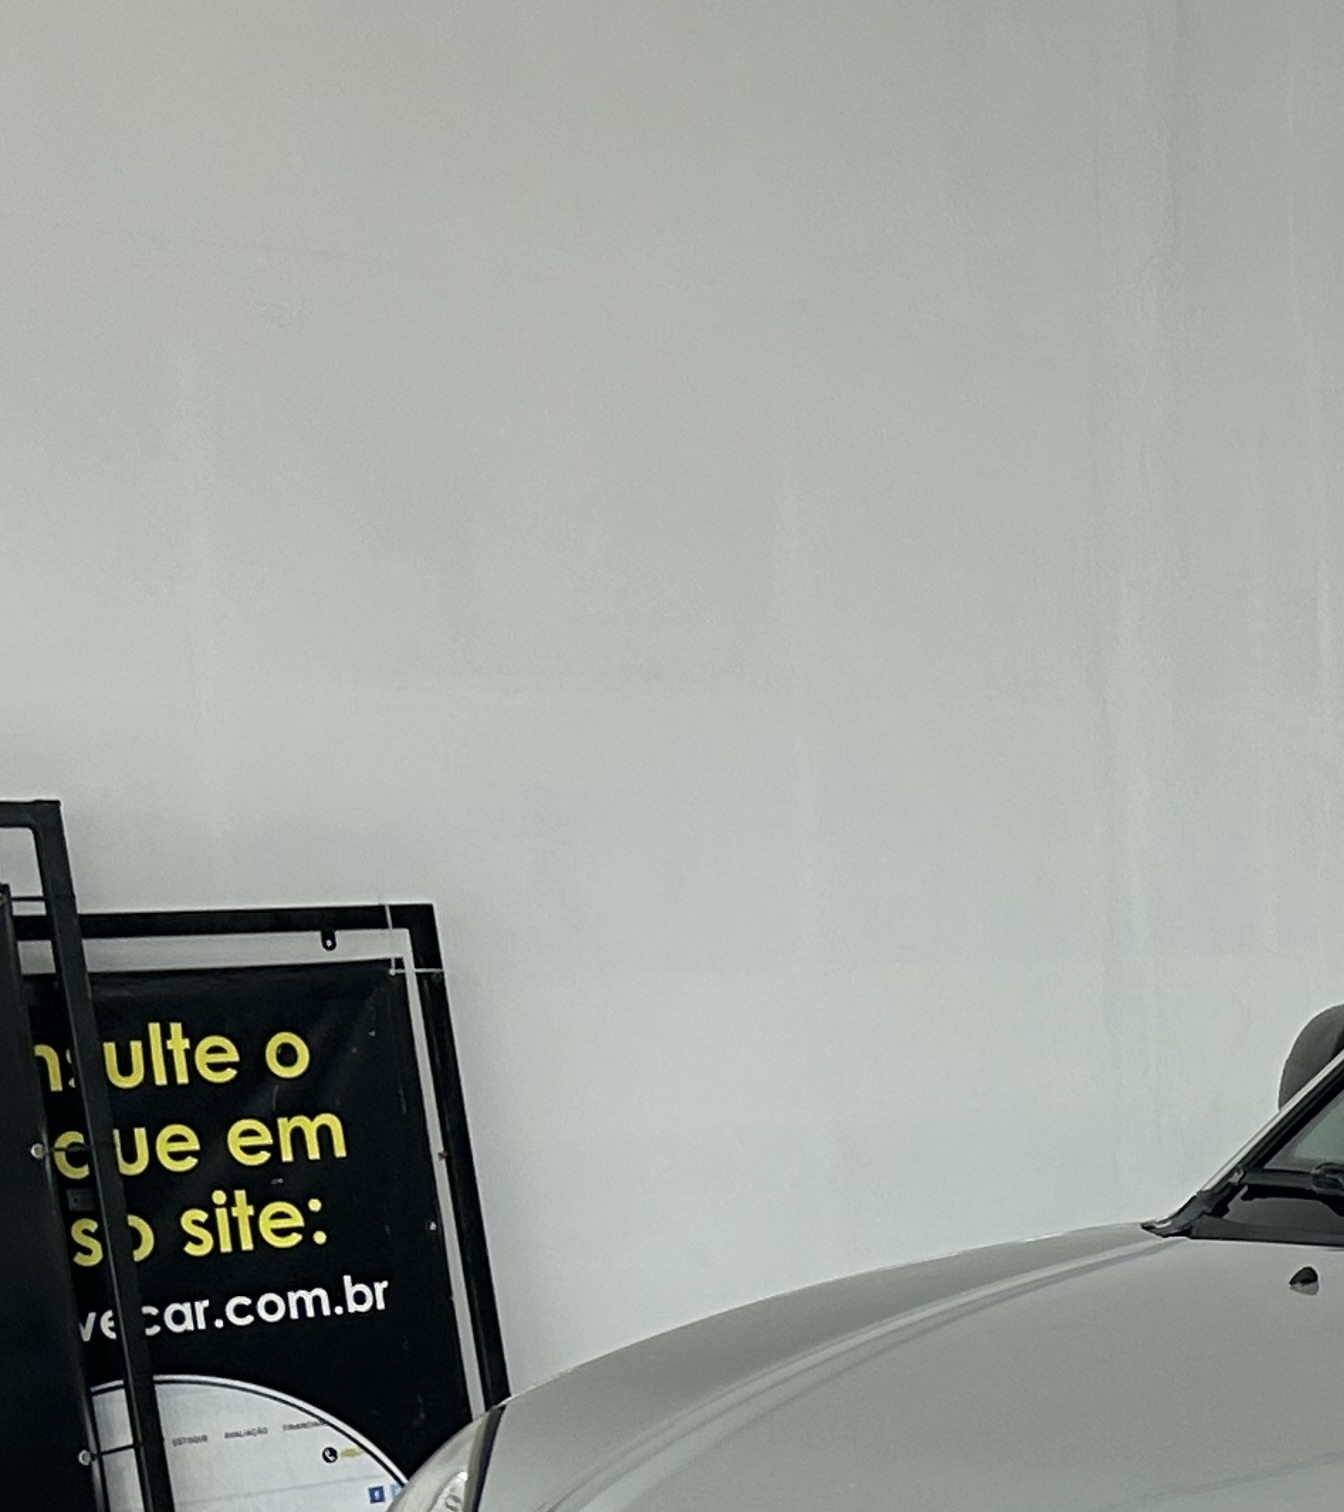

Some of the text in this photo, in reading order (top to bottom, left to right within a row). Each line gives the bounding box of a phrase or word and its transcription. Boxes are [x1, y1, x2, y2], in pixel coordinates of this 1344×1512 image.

[34, 1022, 310, 1092] nulte o
[227, 1113, 346, 1167] em
[180, 1190, 327, 1257] site:
